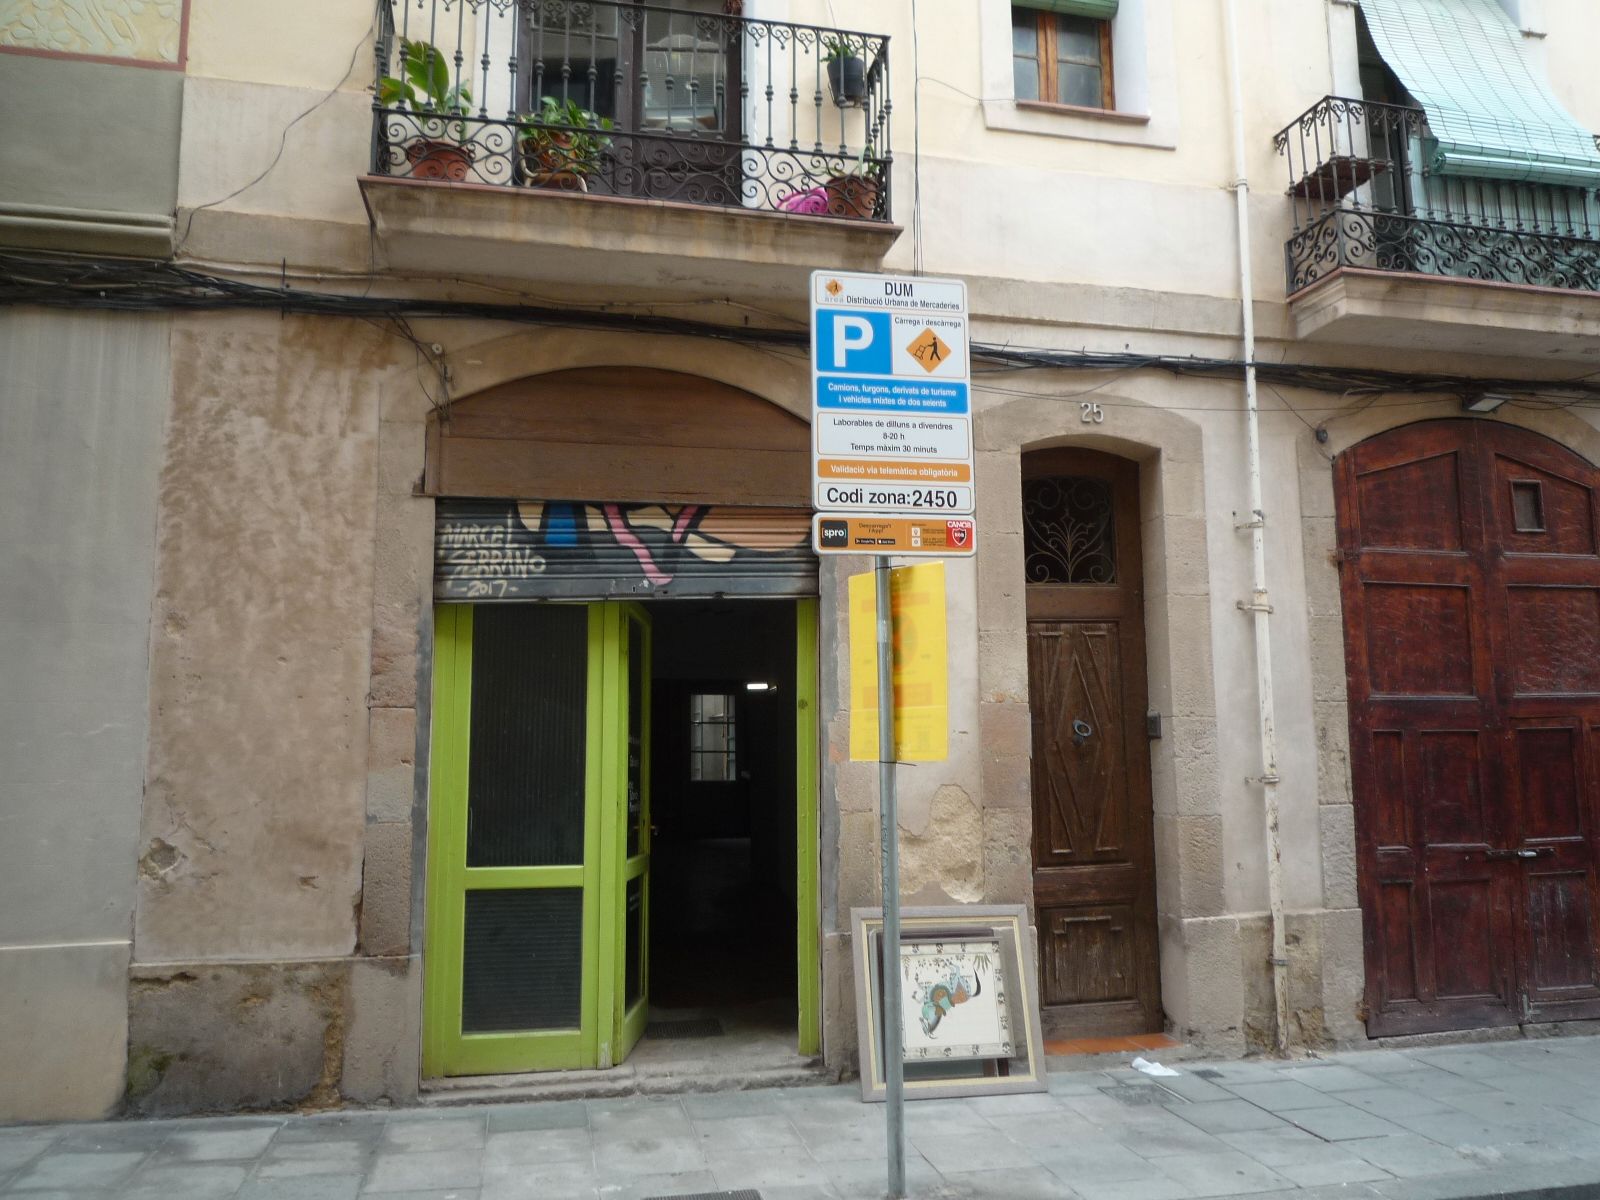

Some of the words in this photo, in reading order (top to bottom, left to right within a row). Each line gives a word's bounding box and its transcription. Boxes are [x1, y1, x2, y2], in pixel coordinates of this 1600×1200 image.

[885, 282, 913, 297] DUM
[847, 295, 883, 305] Distribució
[885, 298, 908, 306] Urbana
[920, 300, 959, 310] Mercaderies
[895, 317, 920, 326] Càrrega
[925, 318, 961, 328] descàrrega
[834, 316, 873, 367] P
[828, 383, 860, 392] Camions,
[862, 384, 890, 394] furgons,
[892, 385, 919, 394] derivats
[921, 387, 929, 395] de
[931, 388, 956, 396] turisme
[843, 396, 871, 404] vehicles
[873, 397, 895, 405] mixtes
[908, 398, 920, 406] dos
[923, 399, 947, 407] seients
[1080, 402, 1104, 423] 25
[834, 418, 873, 427] Laborables
[875, 419, 884, 427] de
[886, 420, 910, 428] dilluns
[919, 422, 953, 430] divendres
[883, 432, 898, 440] 8-20
[851, 443, 874, 452] Temps
[877, 444, 900, 452] màxim
[903, 445, 911, 453] 30
[831, 464, 864, 474] Validació
[866, 466, 878, 474] via
[880, 466, 917, 475] telemàtica
[919, 467, 958, 478] obligatòria
[827, 487, 863, 503] Codi
[440, 511, 517, 547] MARCEL
